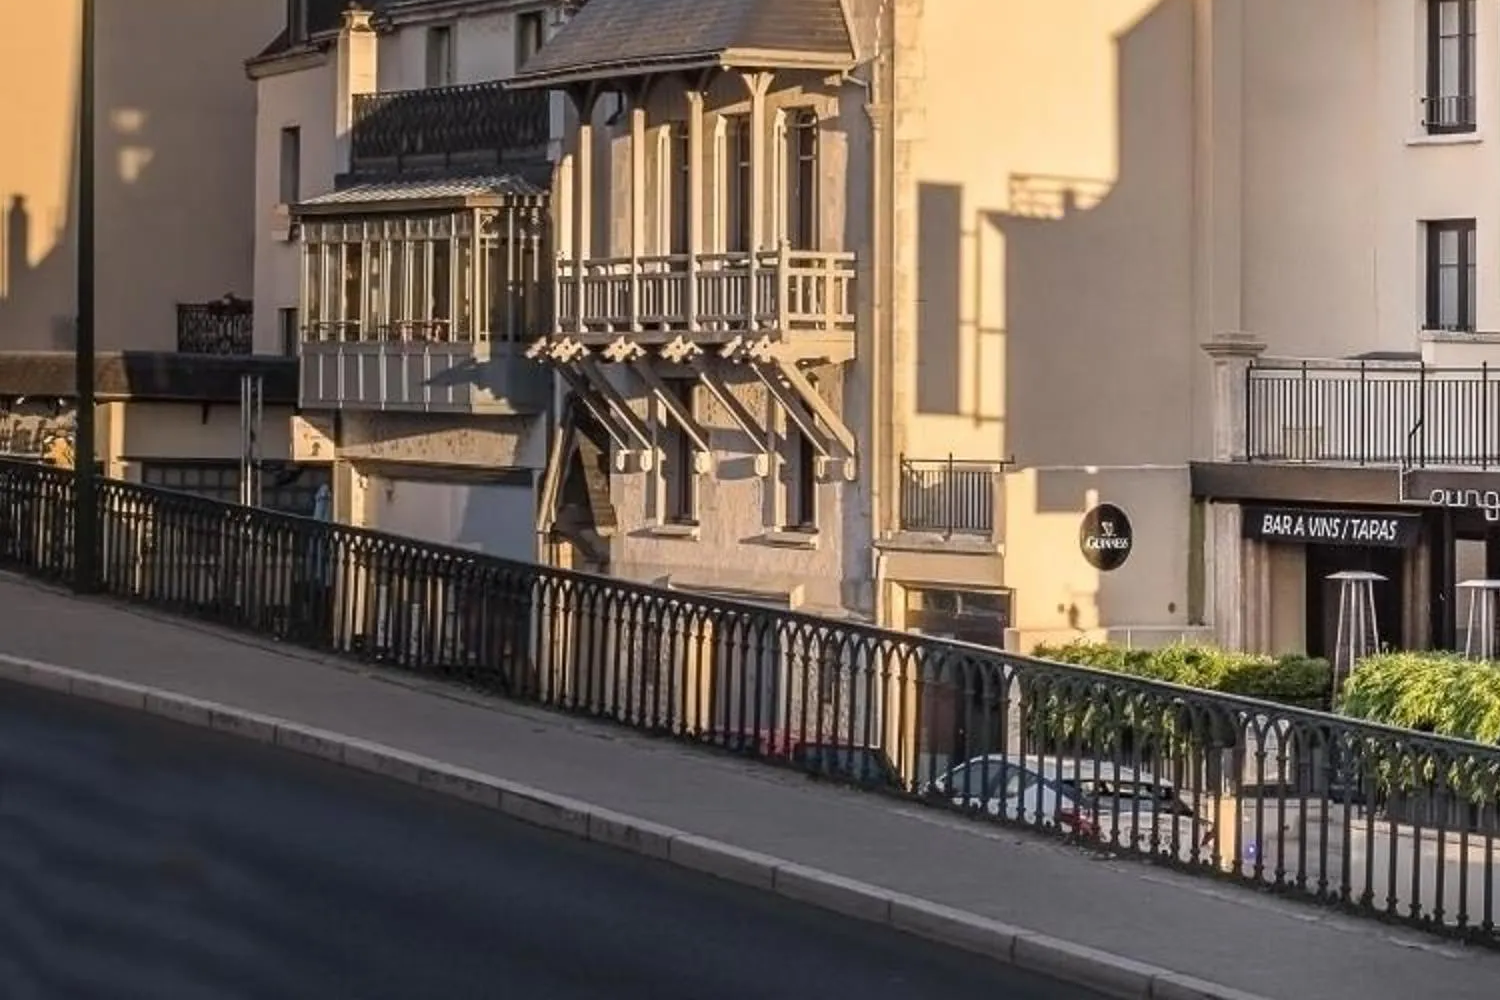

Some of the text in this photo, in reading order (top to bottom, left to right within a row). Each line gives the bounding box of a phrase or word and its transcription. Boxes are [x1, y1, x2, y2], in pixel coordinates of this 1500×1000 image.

[1262, 513, 1292, 535] BAR
[1308, 516, 1340, 538] VINS
[1351, 518, 1398, 540] TAPAS
